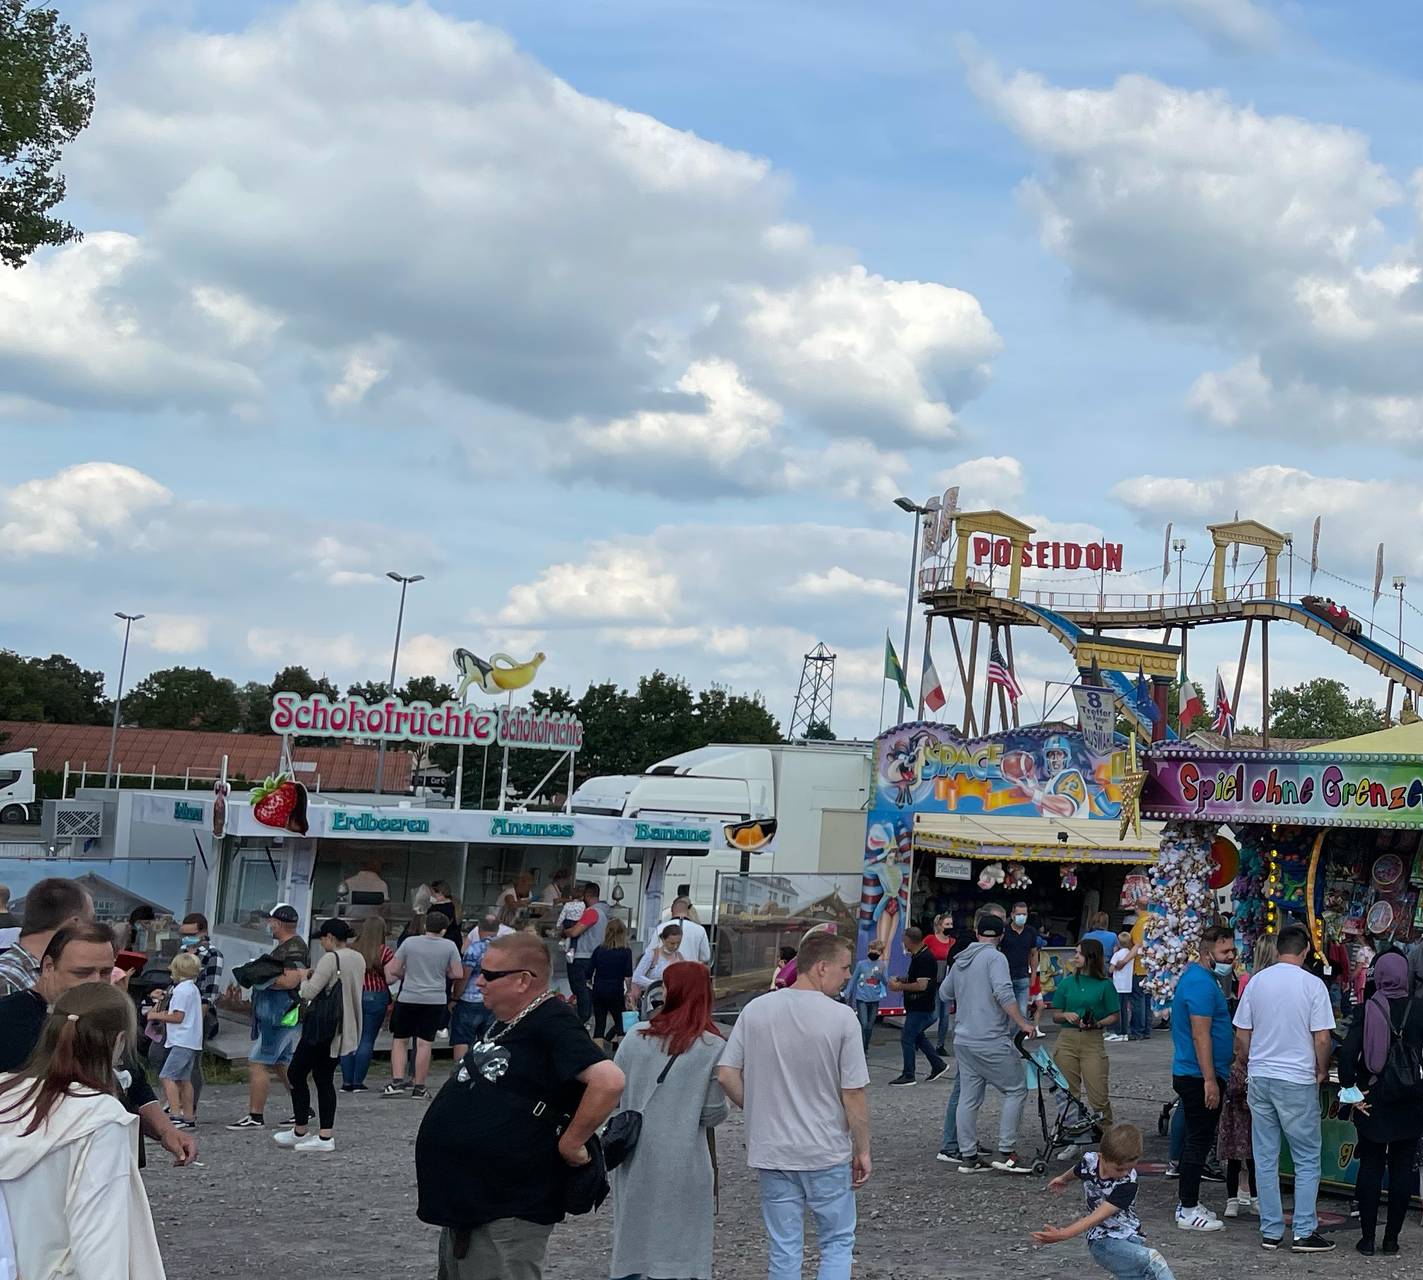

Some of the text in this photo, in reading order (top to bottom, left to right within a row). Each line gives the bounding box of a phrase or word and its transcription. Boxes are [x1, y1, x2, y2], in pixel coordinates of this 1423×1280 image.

[973, 537, 1123, 572] POSEIDON
[1087, 691, 1102, 708] 8
[274, 696, 490, 739] Schokofrüchte
[500, 710, 583, 746] Schokofrüchte
[921, 743, 1003, 781] SPACE
[1180, 764, 1244, 814] Spiel
[1252, 768, 1314, 805] ohne
[333, 812, 430, 833] Erdbeeren
[491, 818, 574, 837] Ananas
[635, 823, 711, 843] Banane
